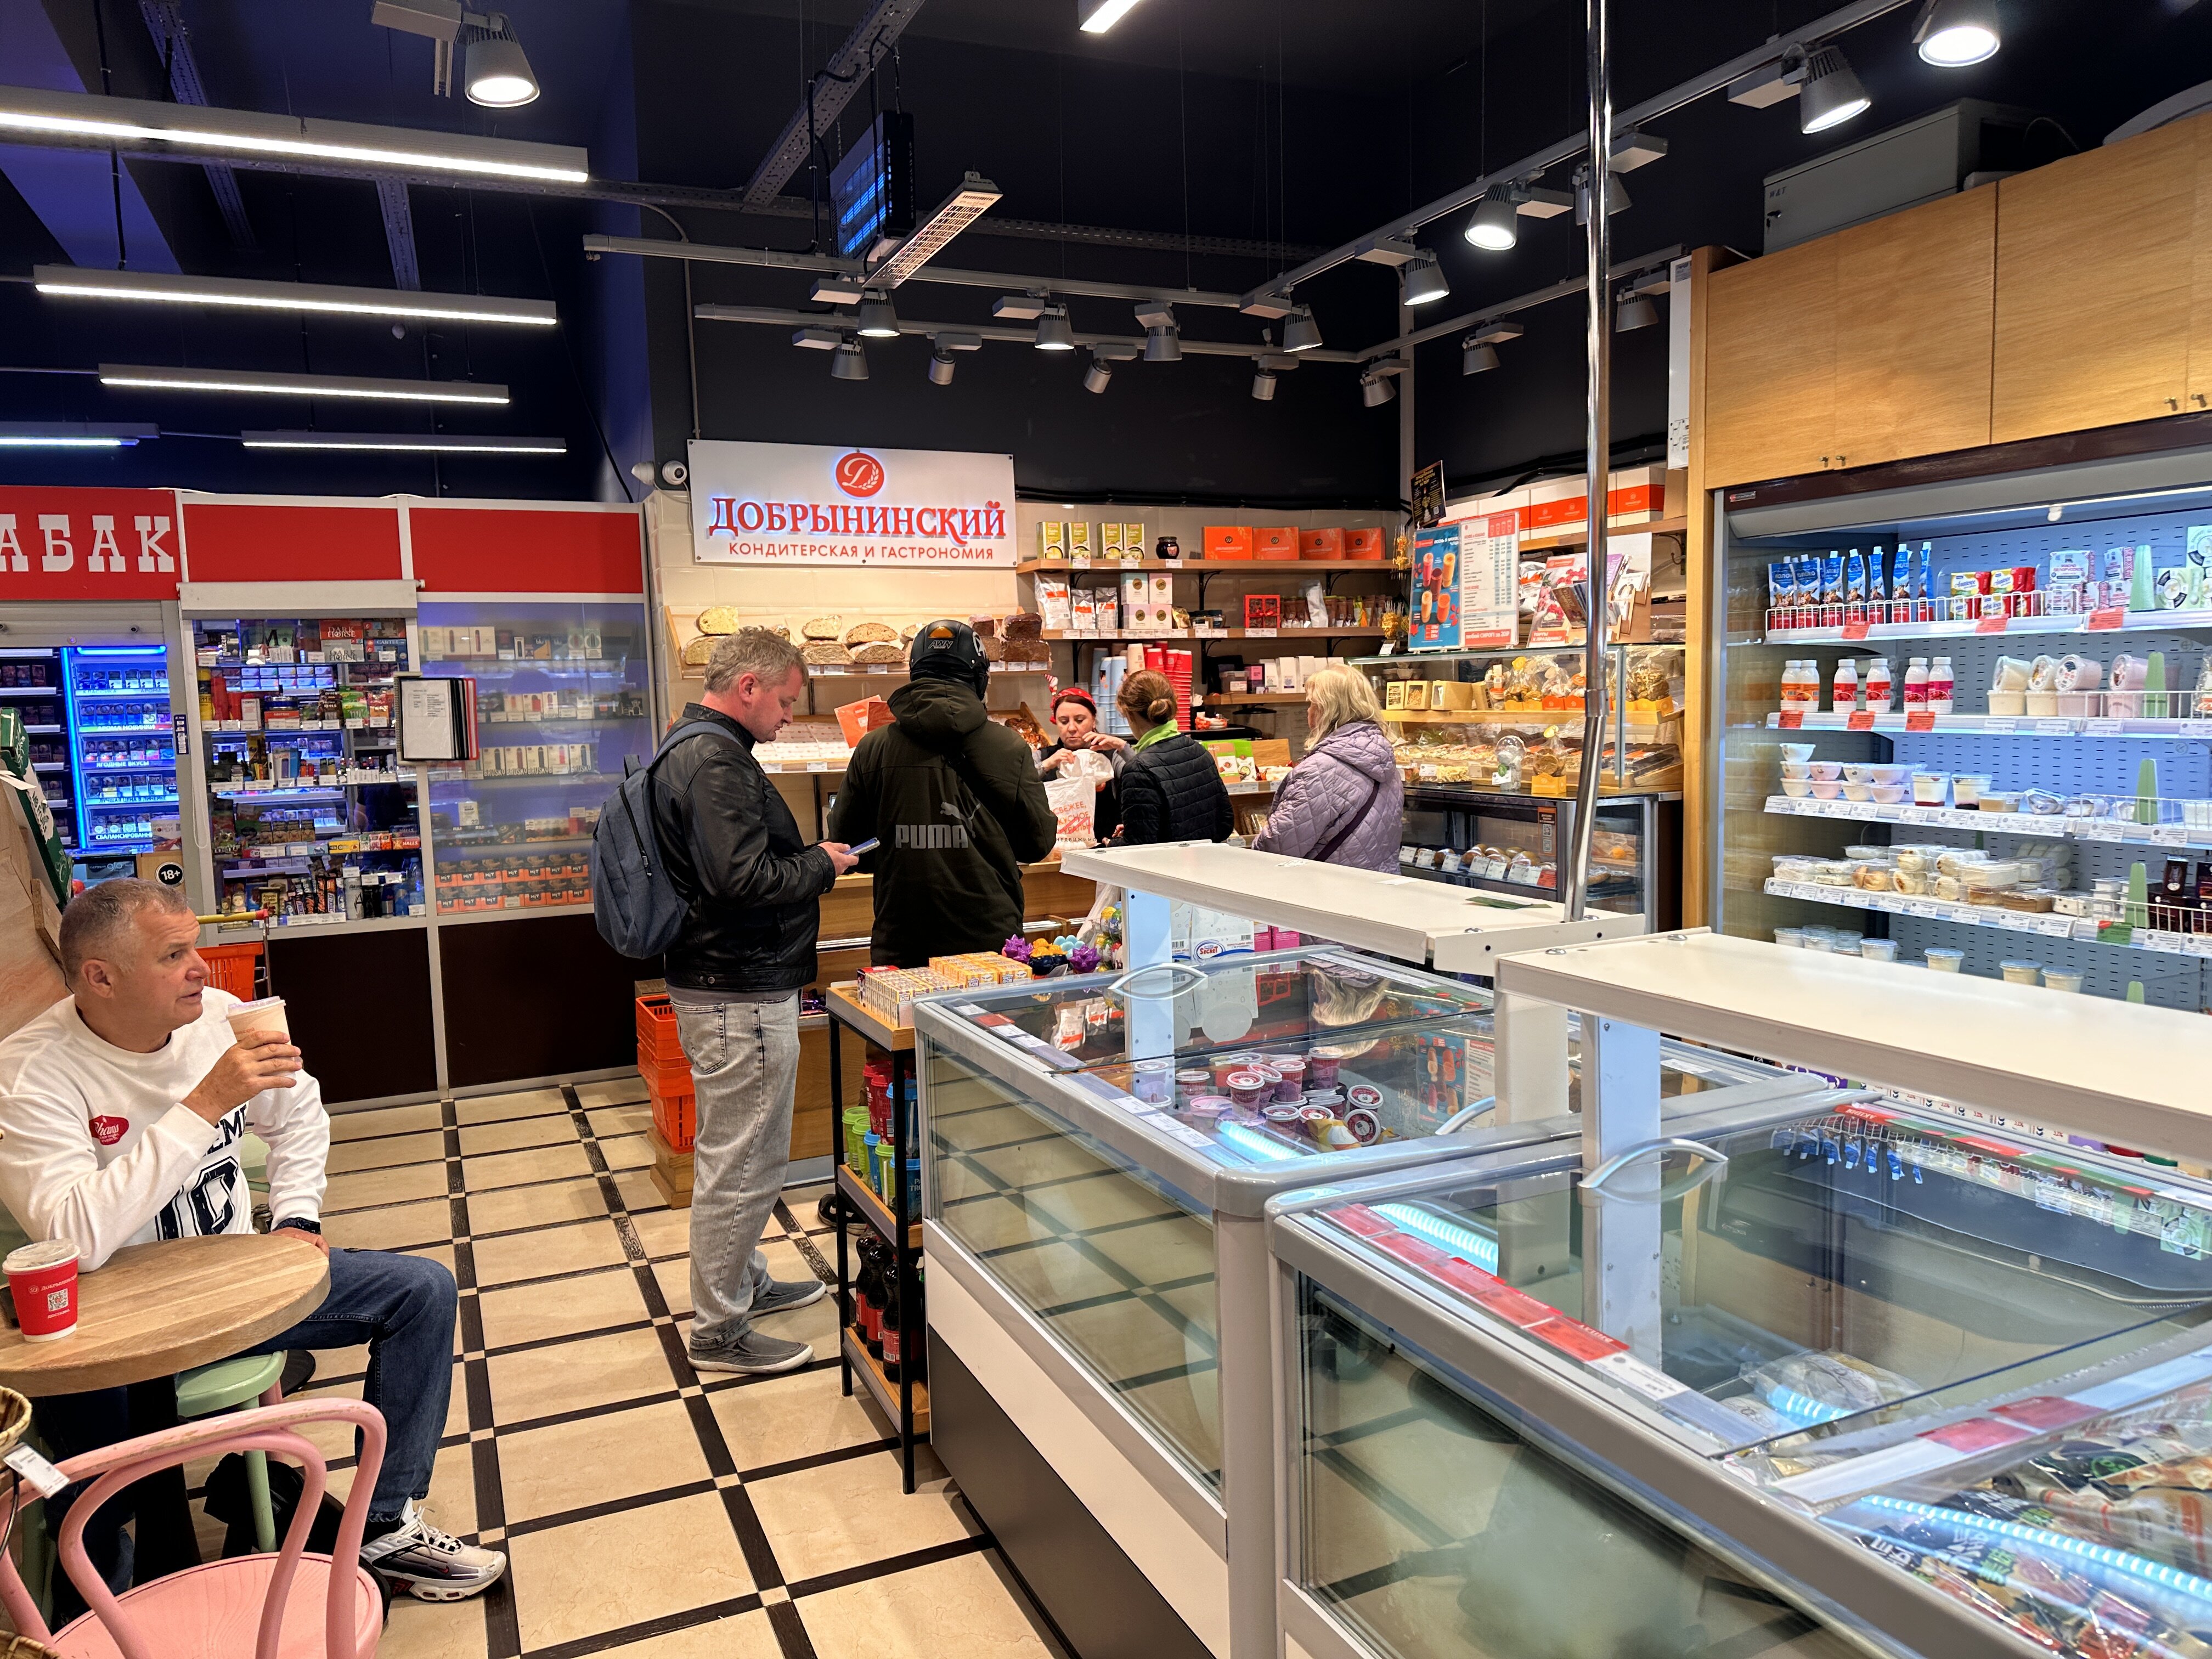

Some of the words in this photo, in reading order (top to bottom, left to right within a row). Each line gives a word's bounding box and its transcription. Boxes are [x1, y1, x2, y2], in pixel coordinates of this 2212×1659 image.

[709, 498, 1006, 545] ДОБРЫНИНСКИЙ
[730, 543, 857, 557] КОНДИТЕРСКАЯ
[865, 545, 874, 557] И
[882, 546, 993, 560] ГАСТРОНОМИЯ
[571, 765, 591, 773] BRUSKO
[1053, 801, 1087, 815] СВЕЖЕЕ,
[1058, 811, 1091, 825] КУСНОЕ,
[896, 825, 968, 849] PUMA
[107, 863, 122, 871] glo
[161, 871, 180, 880] 18+
[1200, 946, 1218, 955] SECRET
